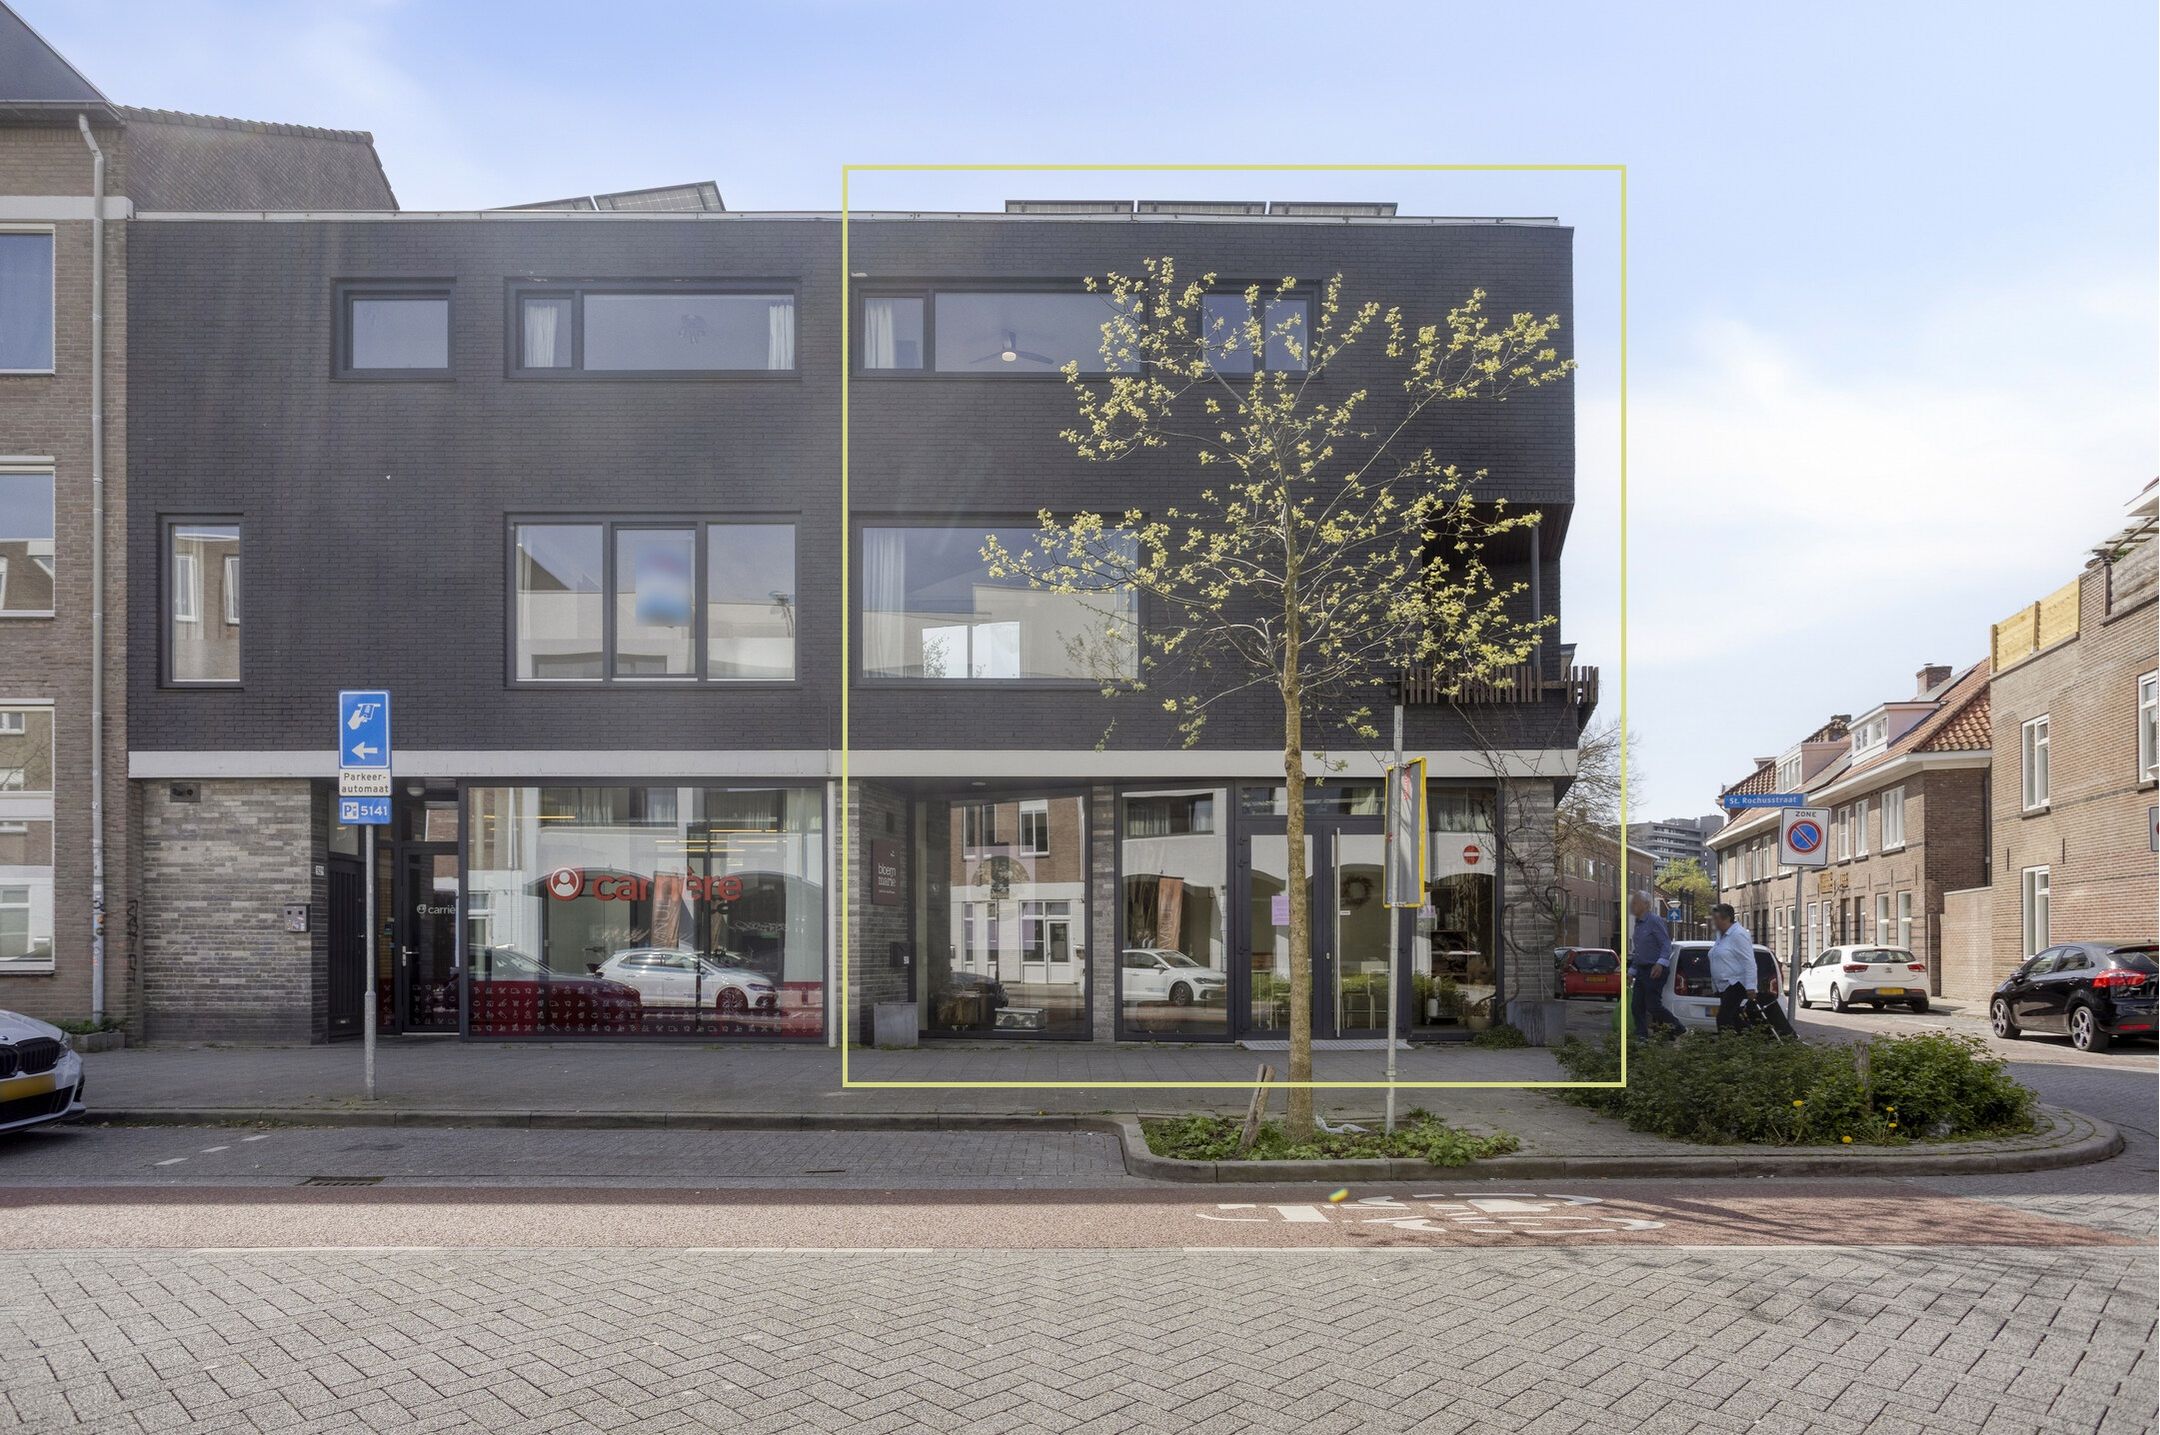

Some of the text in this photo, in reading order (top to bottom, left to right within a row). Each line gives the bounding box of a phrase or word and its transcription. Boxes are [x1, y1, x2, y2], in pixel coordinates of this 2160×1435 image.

[343, 772, 387, 781] Parkeer-
[341, 784, 389, 793] automaat
[1729, 796, 1798, 805] St. Rochusstraat
[360, 805, 388, 816] 5141
